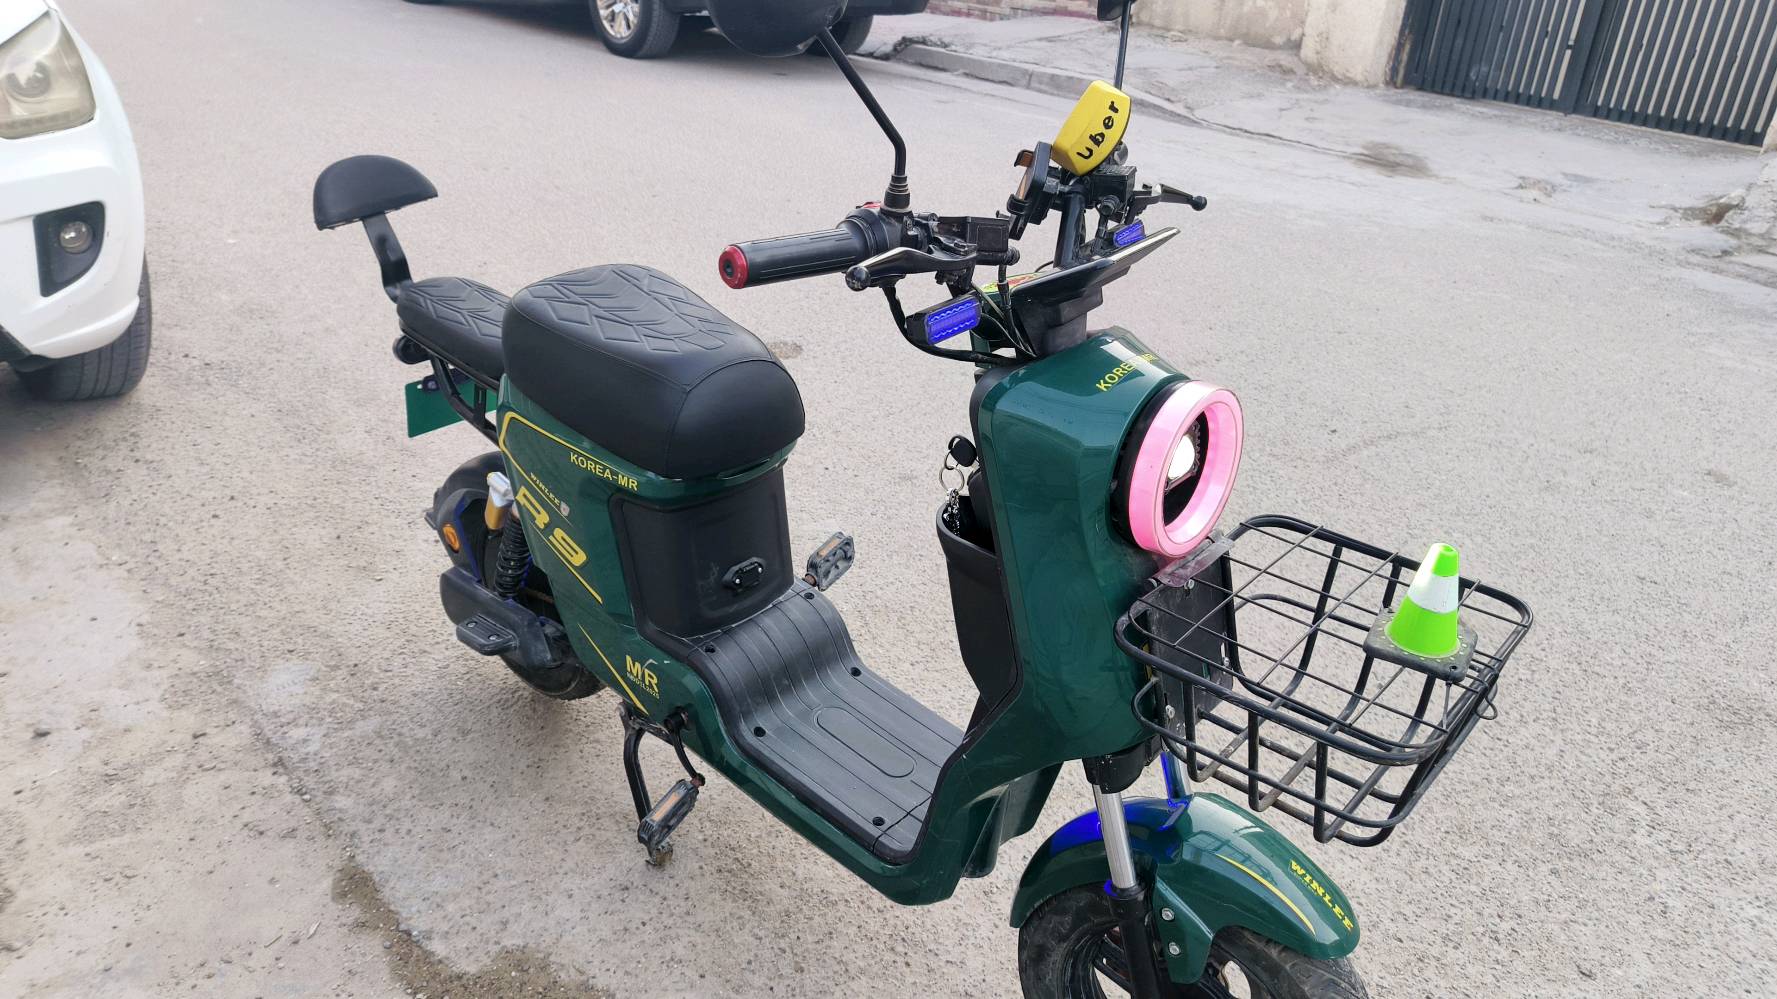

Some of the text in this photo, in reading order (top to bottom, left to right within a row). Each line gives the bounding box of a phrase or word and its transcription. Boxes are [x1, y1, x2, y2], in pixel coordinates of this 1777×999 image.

[570, 453, 638, 491] KOREA-MR
[626, 654, 659, 693] MR
[1291, 860, 1354, 931] WINLEE
